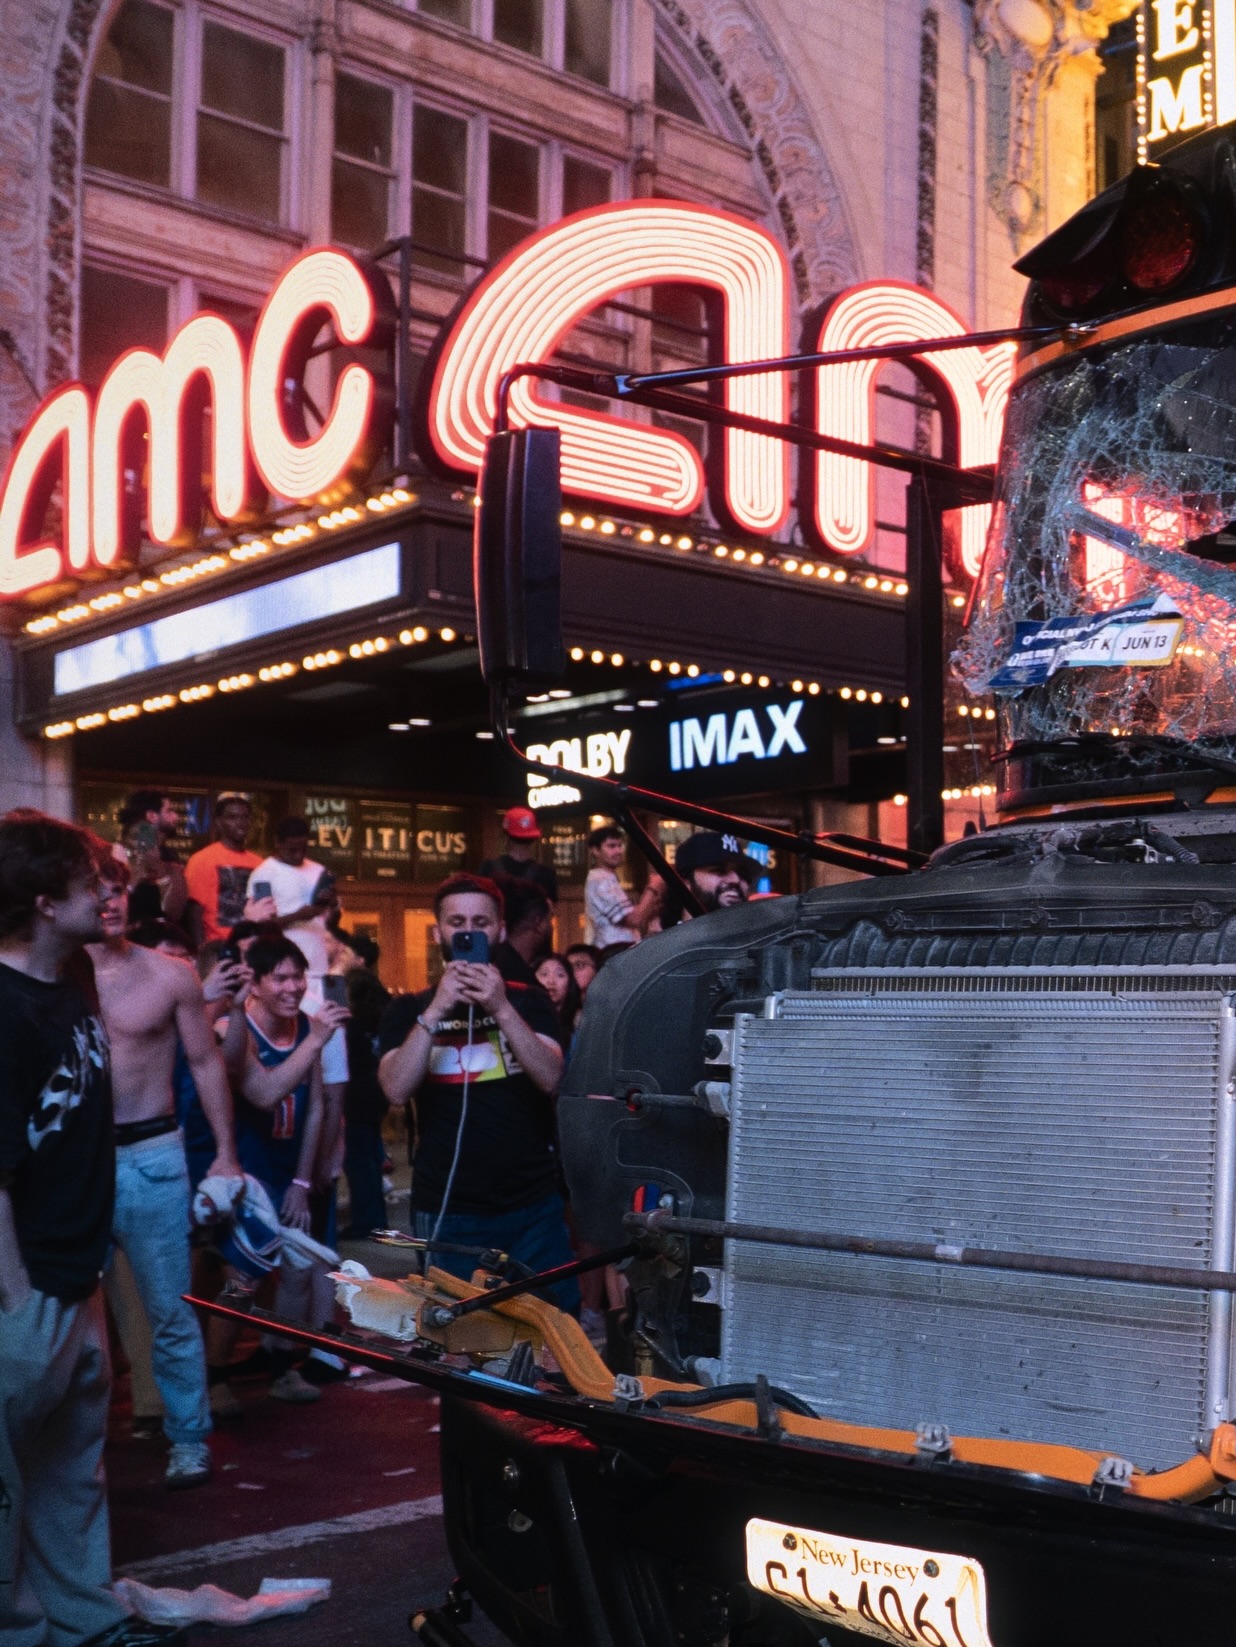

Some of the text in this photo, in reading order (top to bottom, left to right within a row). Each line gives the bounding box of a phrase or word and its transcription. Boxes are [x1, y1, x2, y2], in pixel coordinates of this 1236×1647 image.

[1122, 635, 1168, 650] JUN 13
[526, 729, 631, 787] DOLBY
[669, 700, 807, 771] IMAX
[800, 1536, 920, 1586] New Jersey
